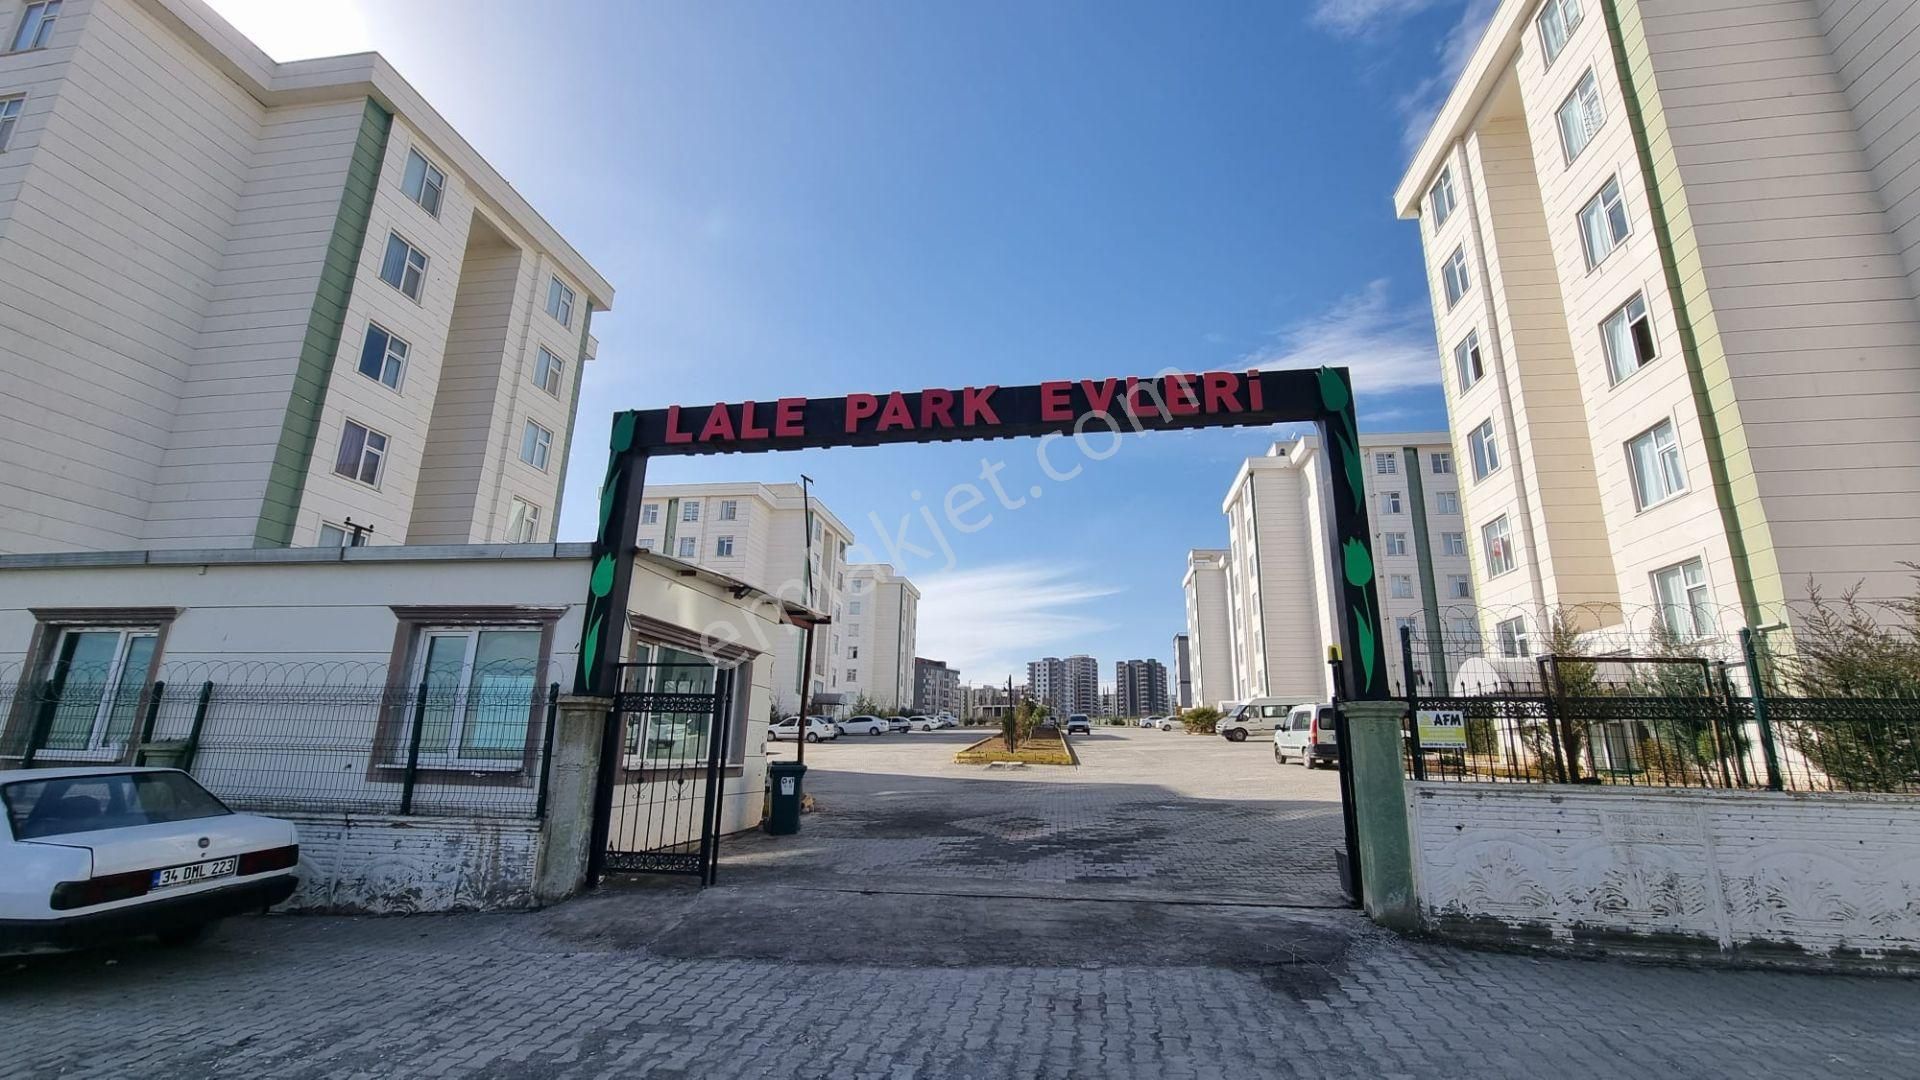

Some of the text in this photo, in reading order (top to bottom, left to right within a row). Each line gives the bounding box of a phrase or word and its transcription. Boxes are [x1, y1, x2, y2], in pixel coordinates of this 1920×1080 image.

[665, 397, 807, 444] LALE
[845, 385, 1001, 433] PARK
[1433, 713, 1462, 726] AFM
[162, 860, 234, 883] 34 DML 223
